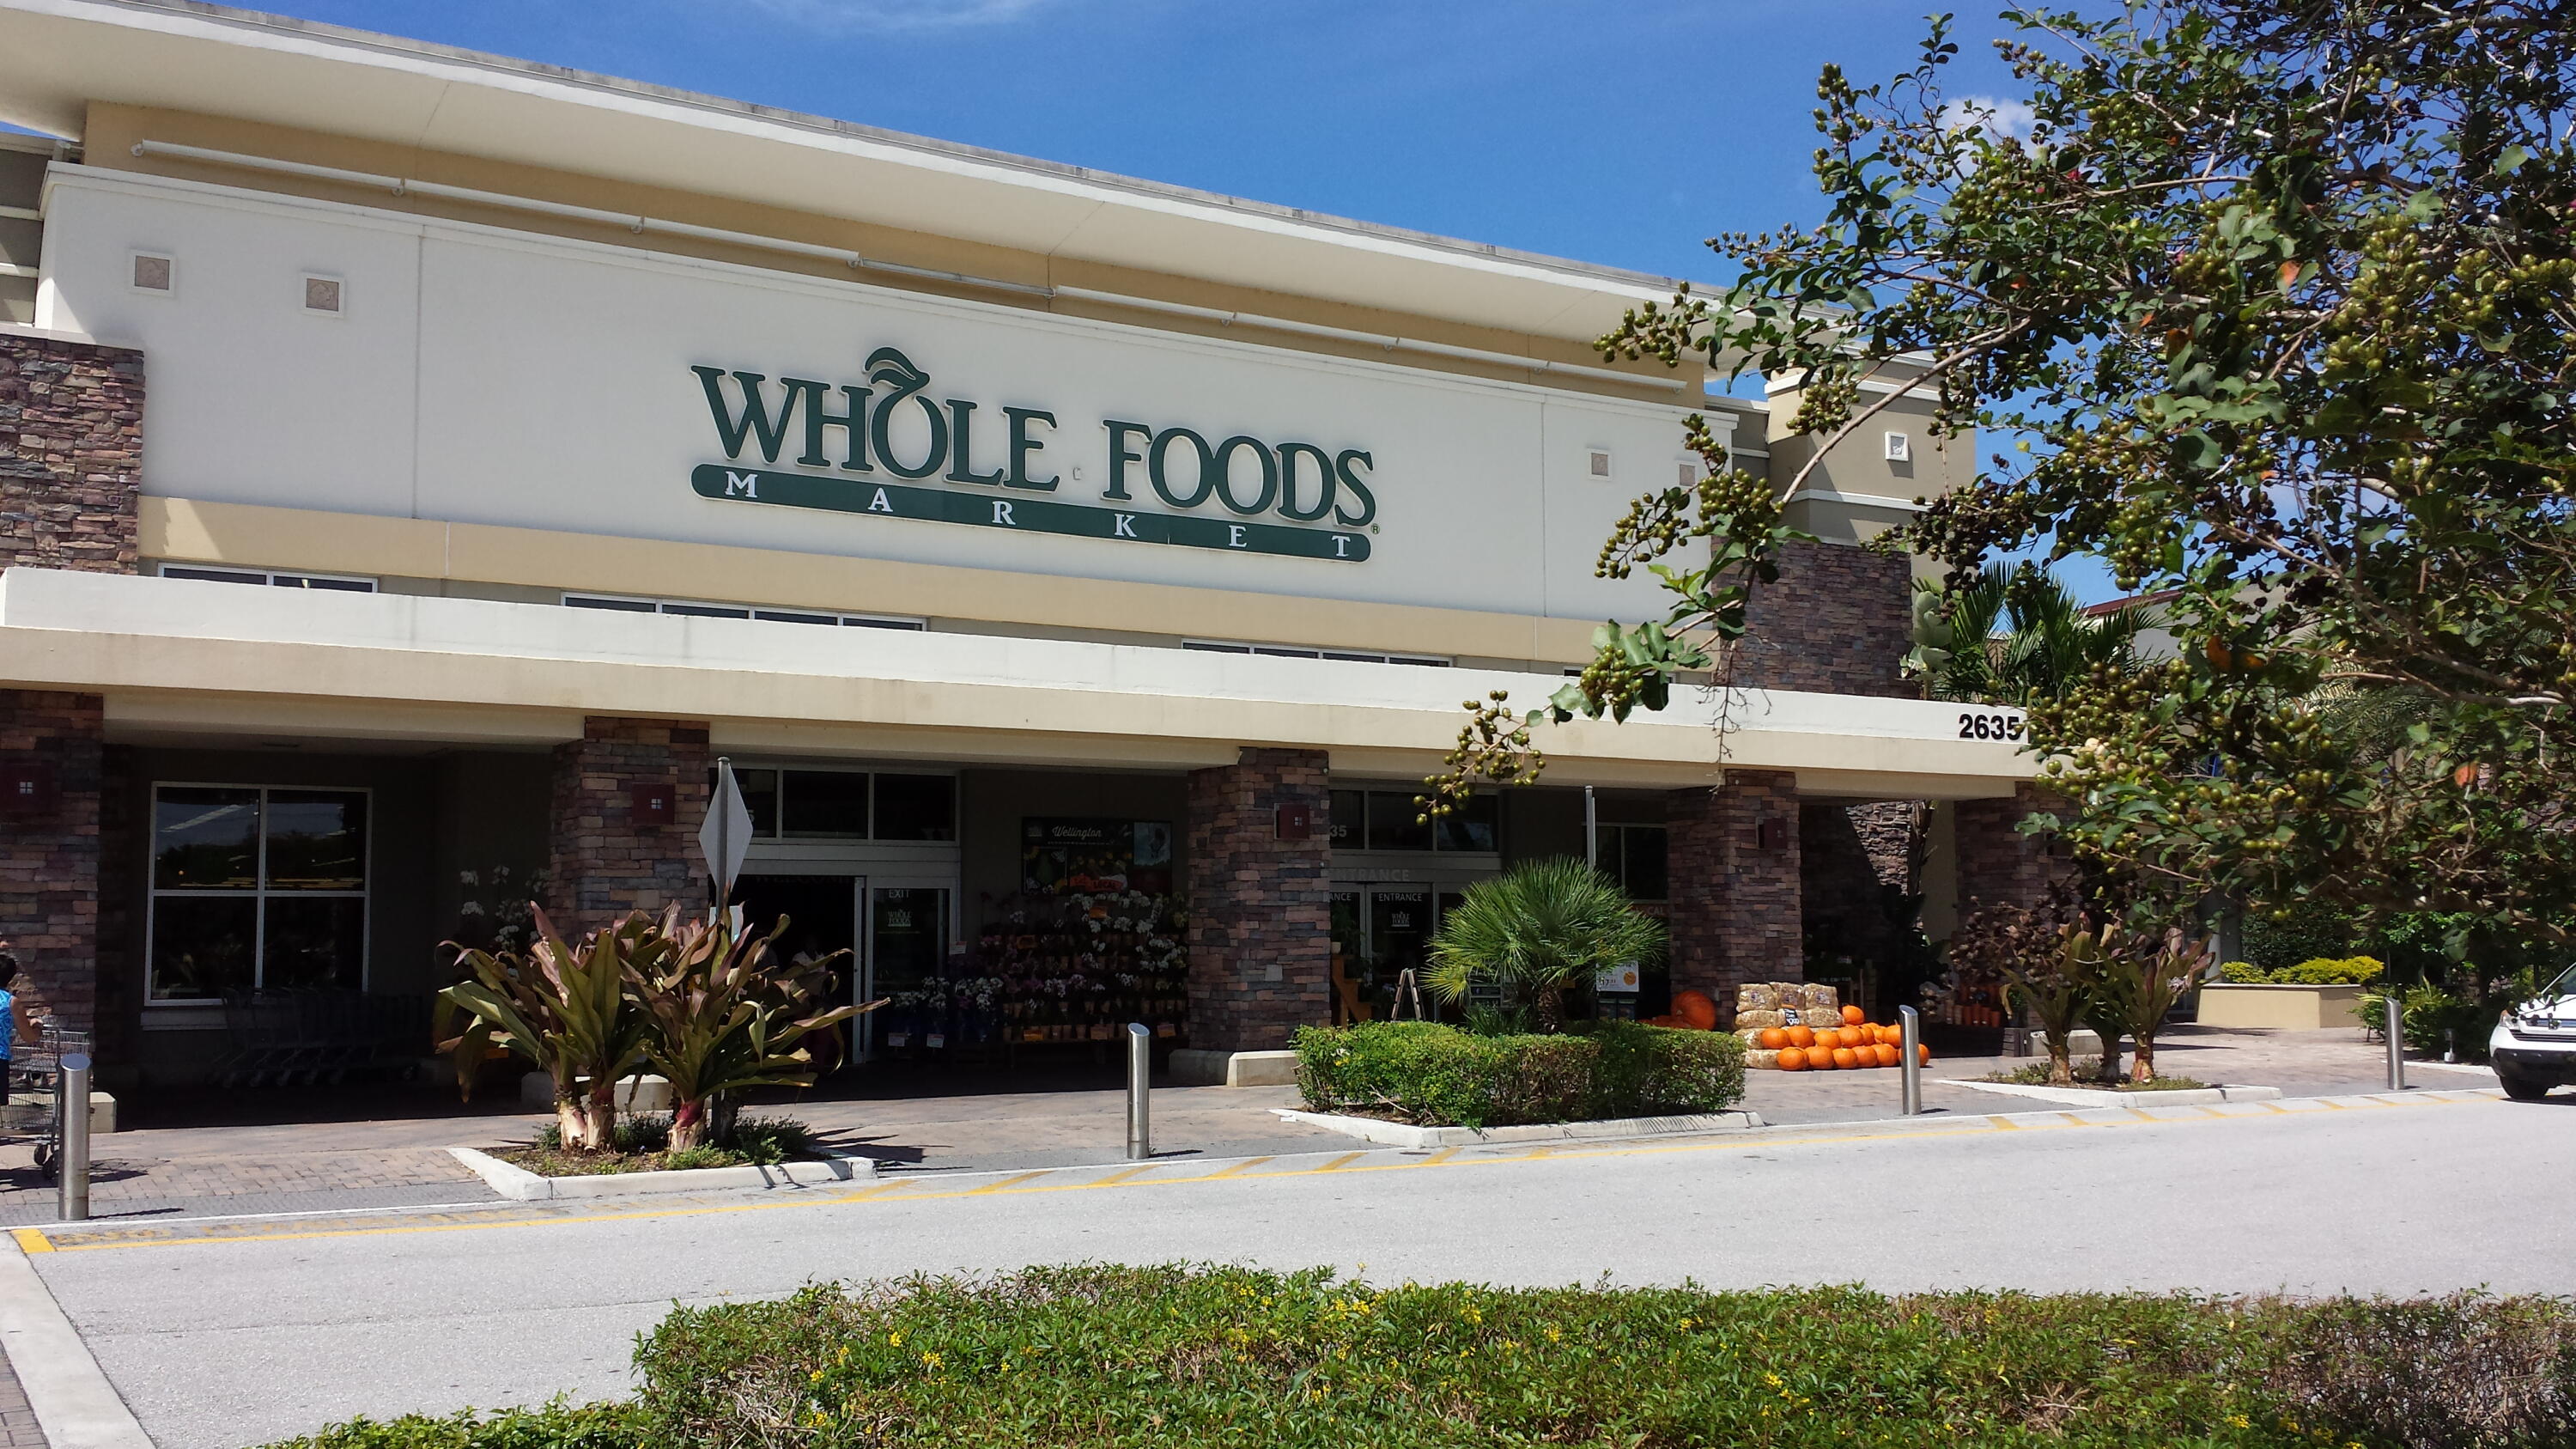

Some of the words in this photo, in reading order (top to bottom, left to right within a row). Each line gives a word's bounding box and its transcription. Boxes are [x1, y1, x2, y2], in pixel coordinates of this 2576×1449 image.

[690, 348, 1060, 492] WHOLE
[1102, 419, 1376, 527] FOODS
[725, 470, 1353, 558] MARKET
[1959, 714, 2023, 740] 2635
[1052, 825, 1102, 840] Wellington
[889, 889, 909, 898] EXIT
[1378, 892, 1423, 901] ENTRANCE
